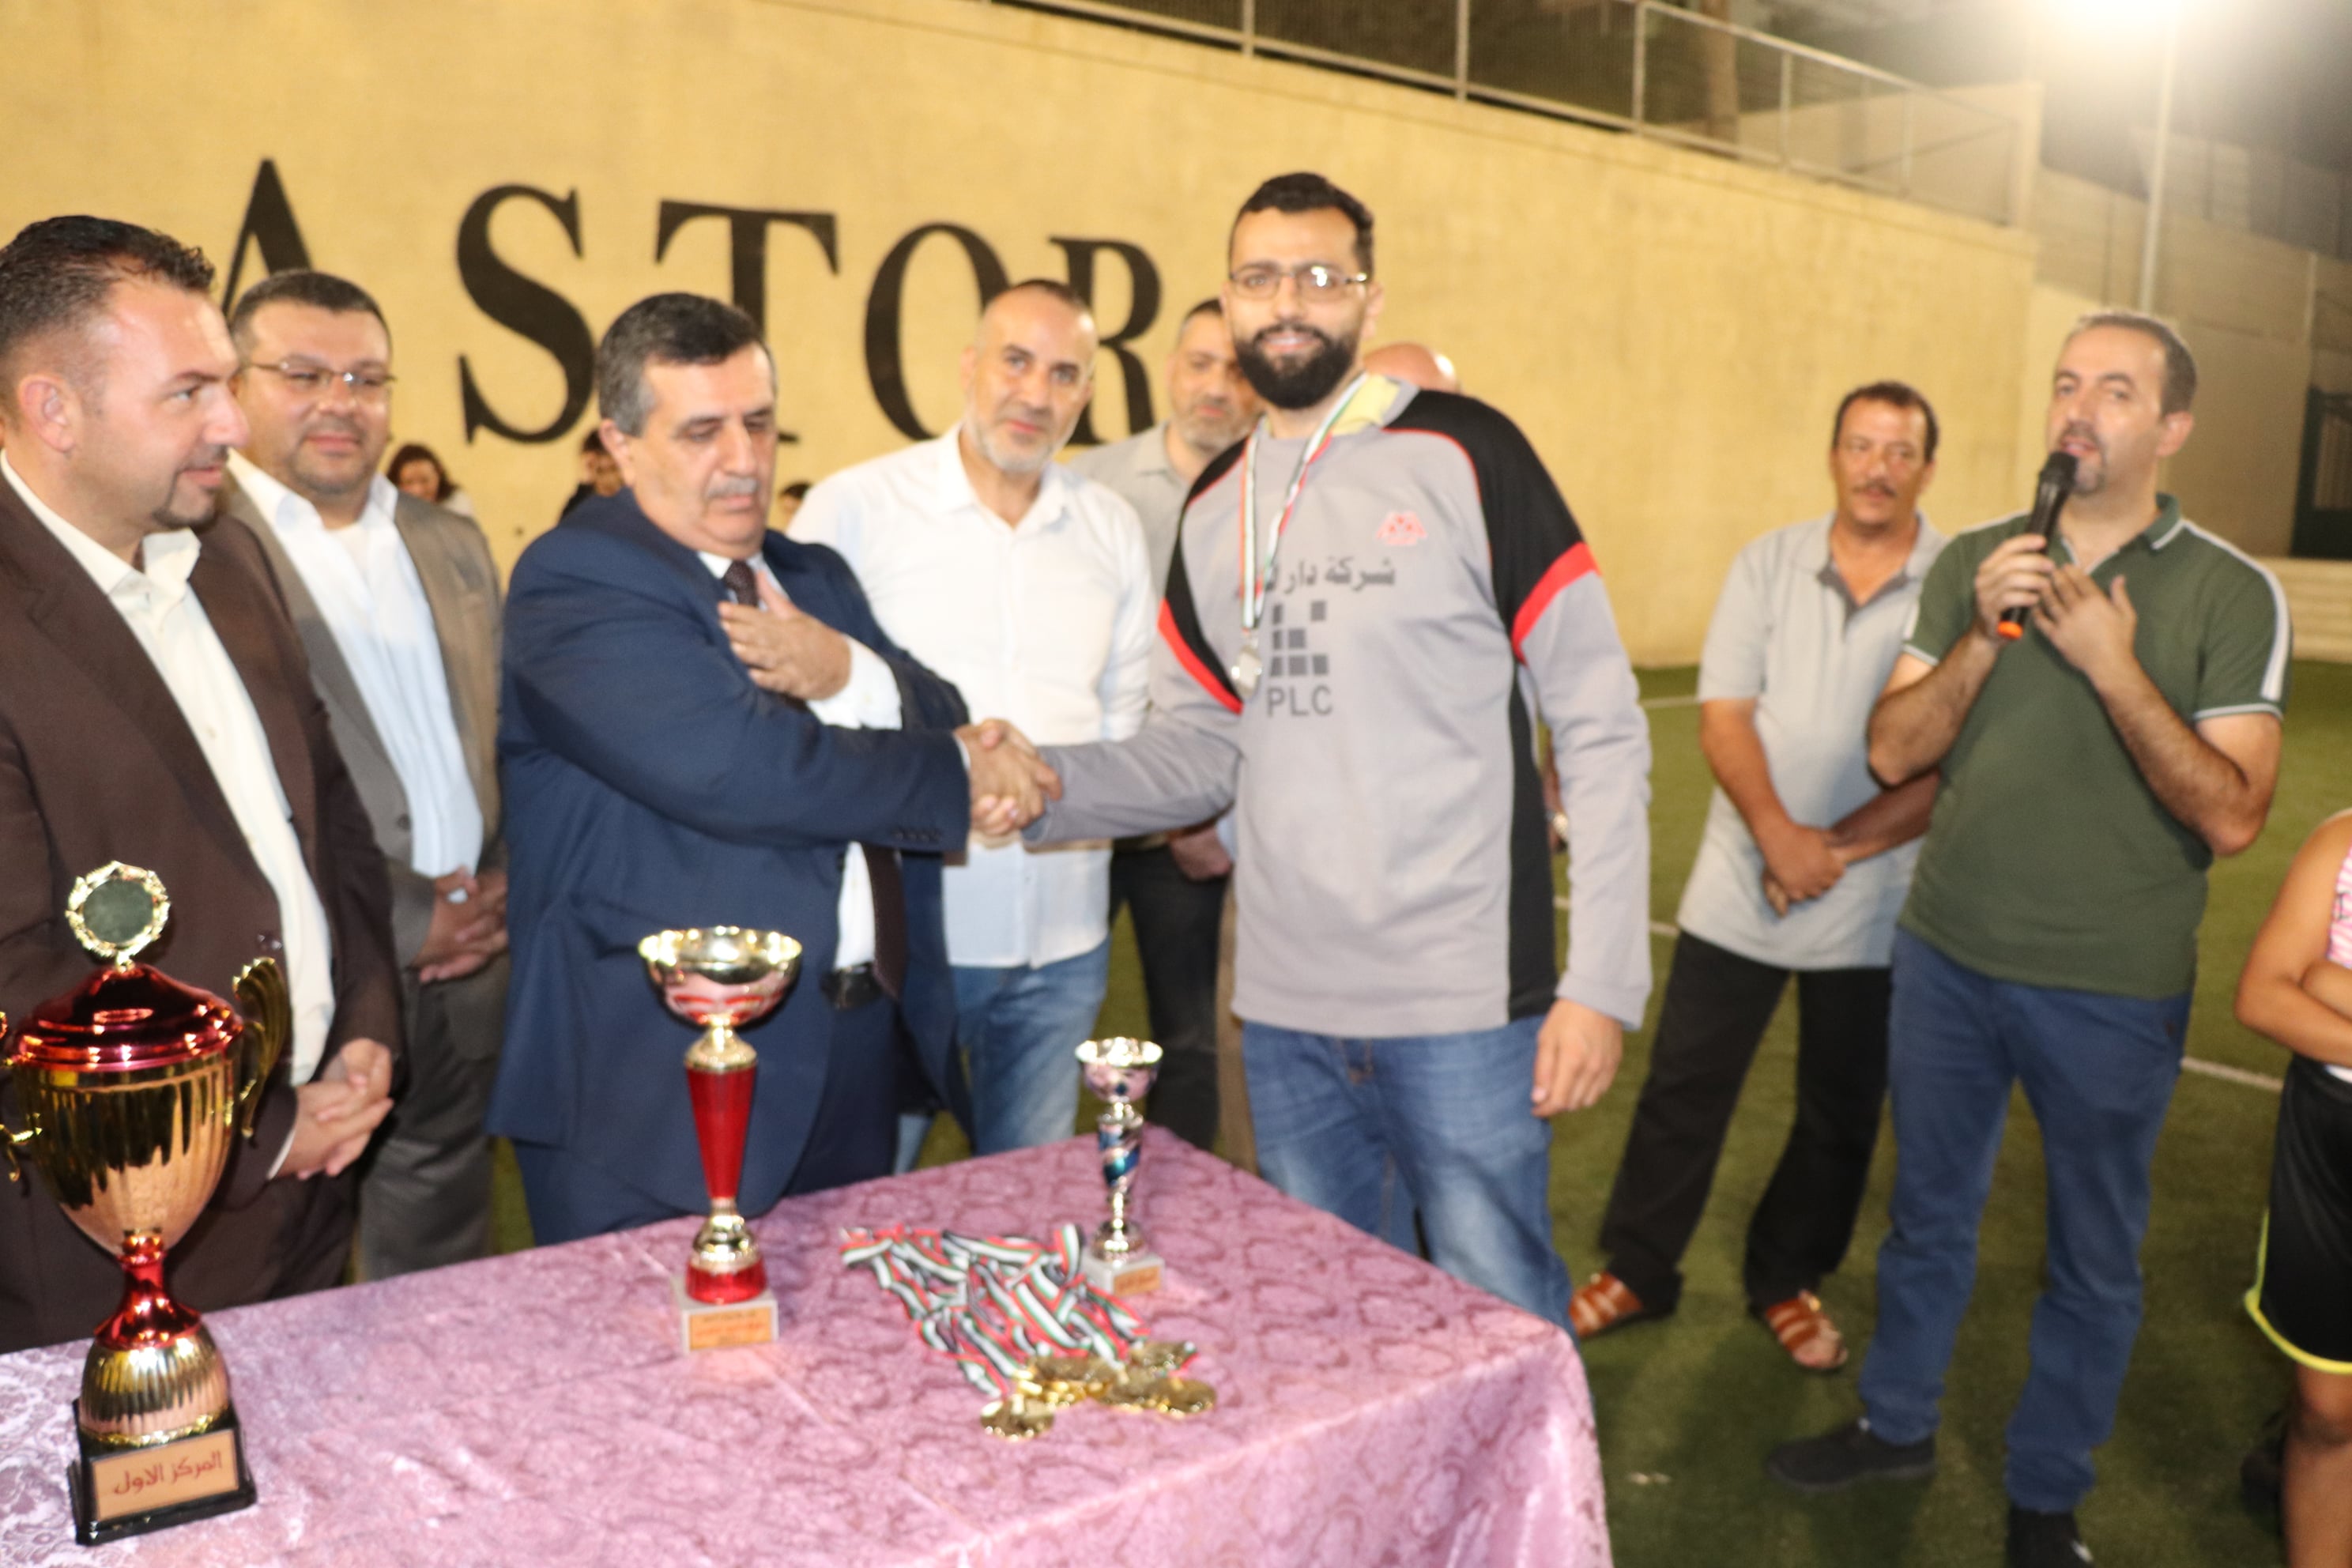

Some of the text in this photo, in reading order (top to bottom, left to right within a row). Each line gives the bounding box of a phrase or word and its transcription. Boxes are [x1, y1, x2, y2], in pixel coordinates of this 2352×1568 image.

[1325, 556, 1396, 593] شركة
[1267, 684, 1333, 717] PLC
[114, 1449, 223, 1495] المركز الاول
